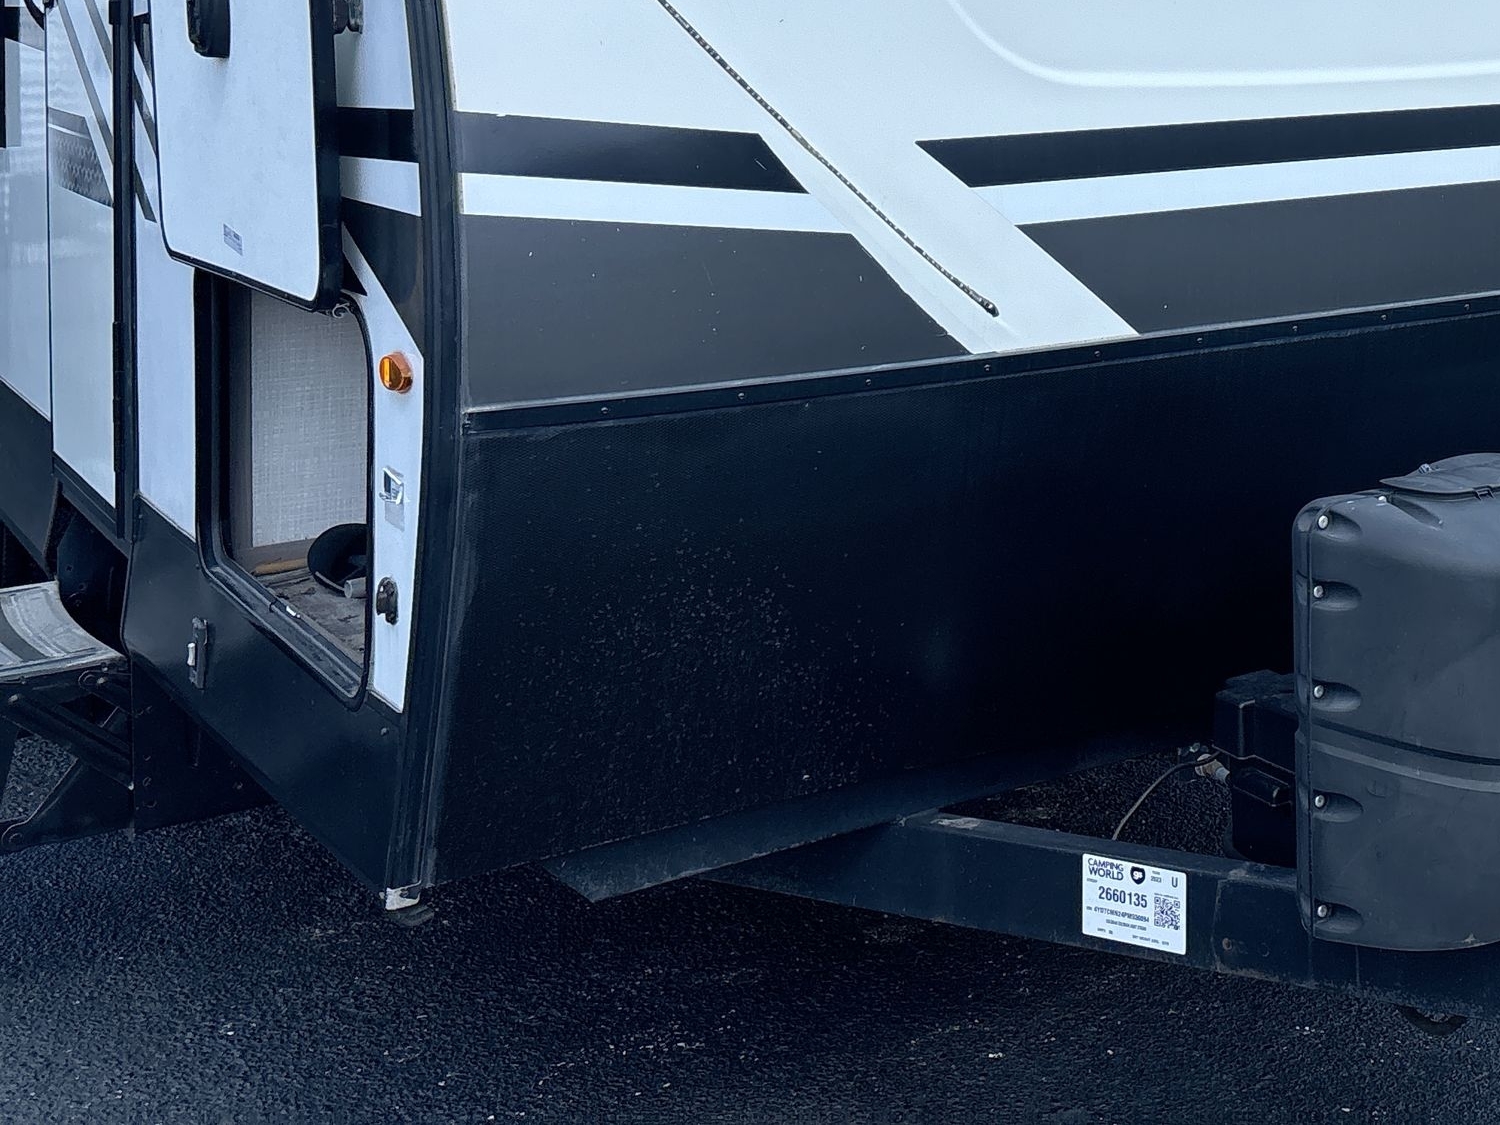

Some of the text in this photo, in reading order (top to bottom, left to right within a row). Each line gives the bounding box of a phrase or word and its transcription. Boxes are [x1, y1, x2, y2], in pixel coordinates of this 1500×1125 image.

[1087, 858, 1124, 872] CAMPING
[1088, 866, 1124, 881] WORLD
[1171, 876, 1179, 888] U
[1098, 886, 1148, 909] 2660135
